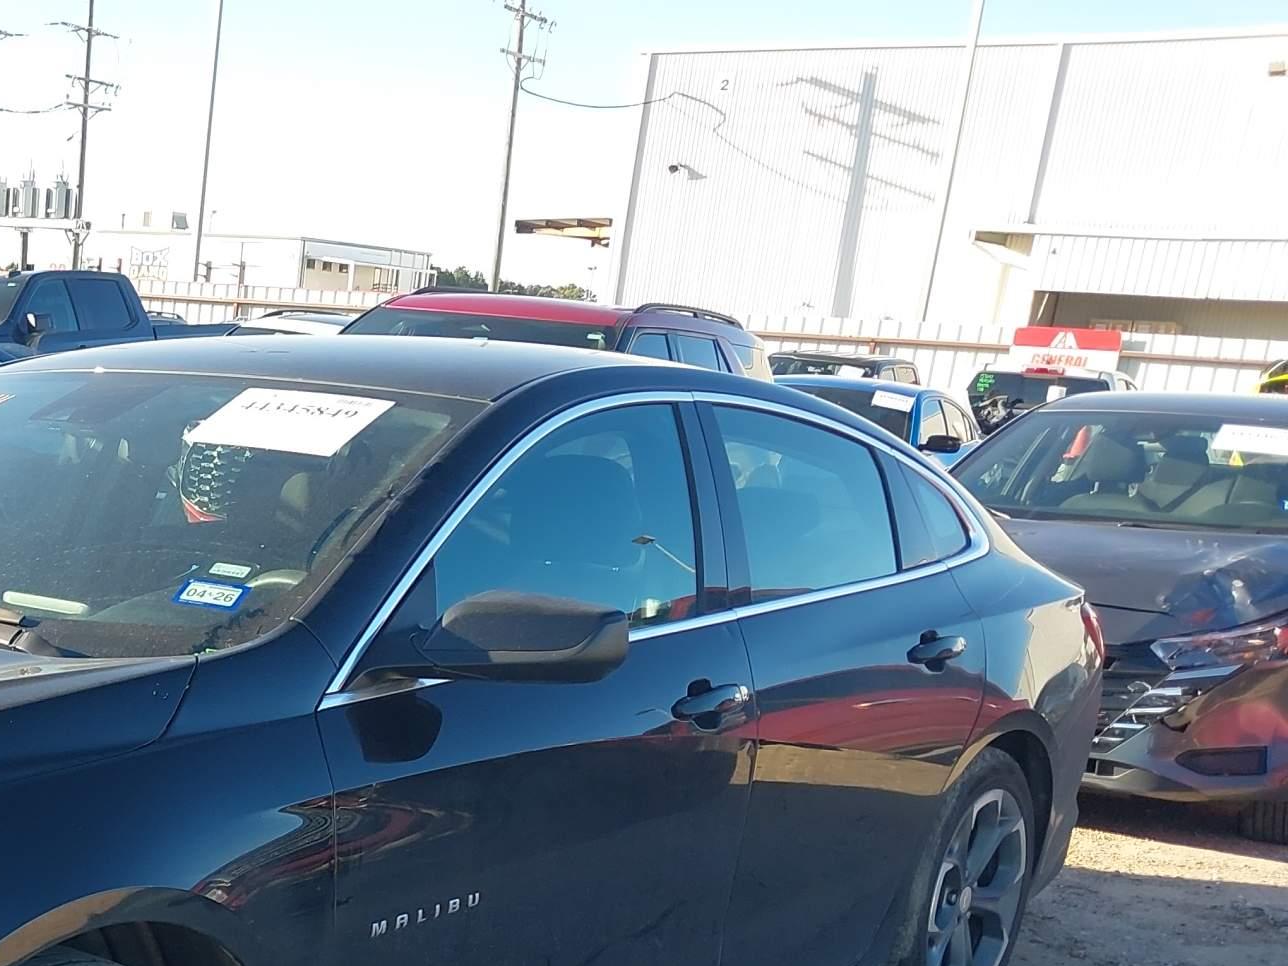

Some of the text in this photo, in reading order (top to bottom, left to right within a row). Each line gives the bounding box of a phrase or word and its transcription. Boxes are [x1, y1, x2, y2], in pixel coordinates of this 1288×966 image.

[720, 79, 730, 91] 2
[130, 246, 170, 267] BOX
[370, 891, 481, 938] MALIBU
